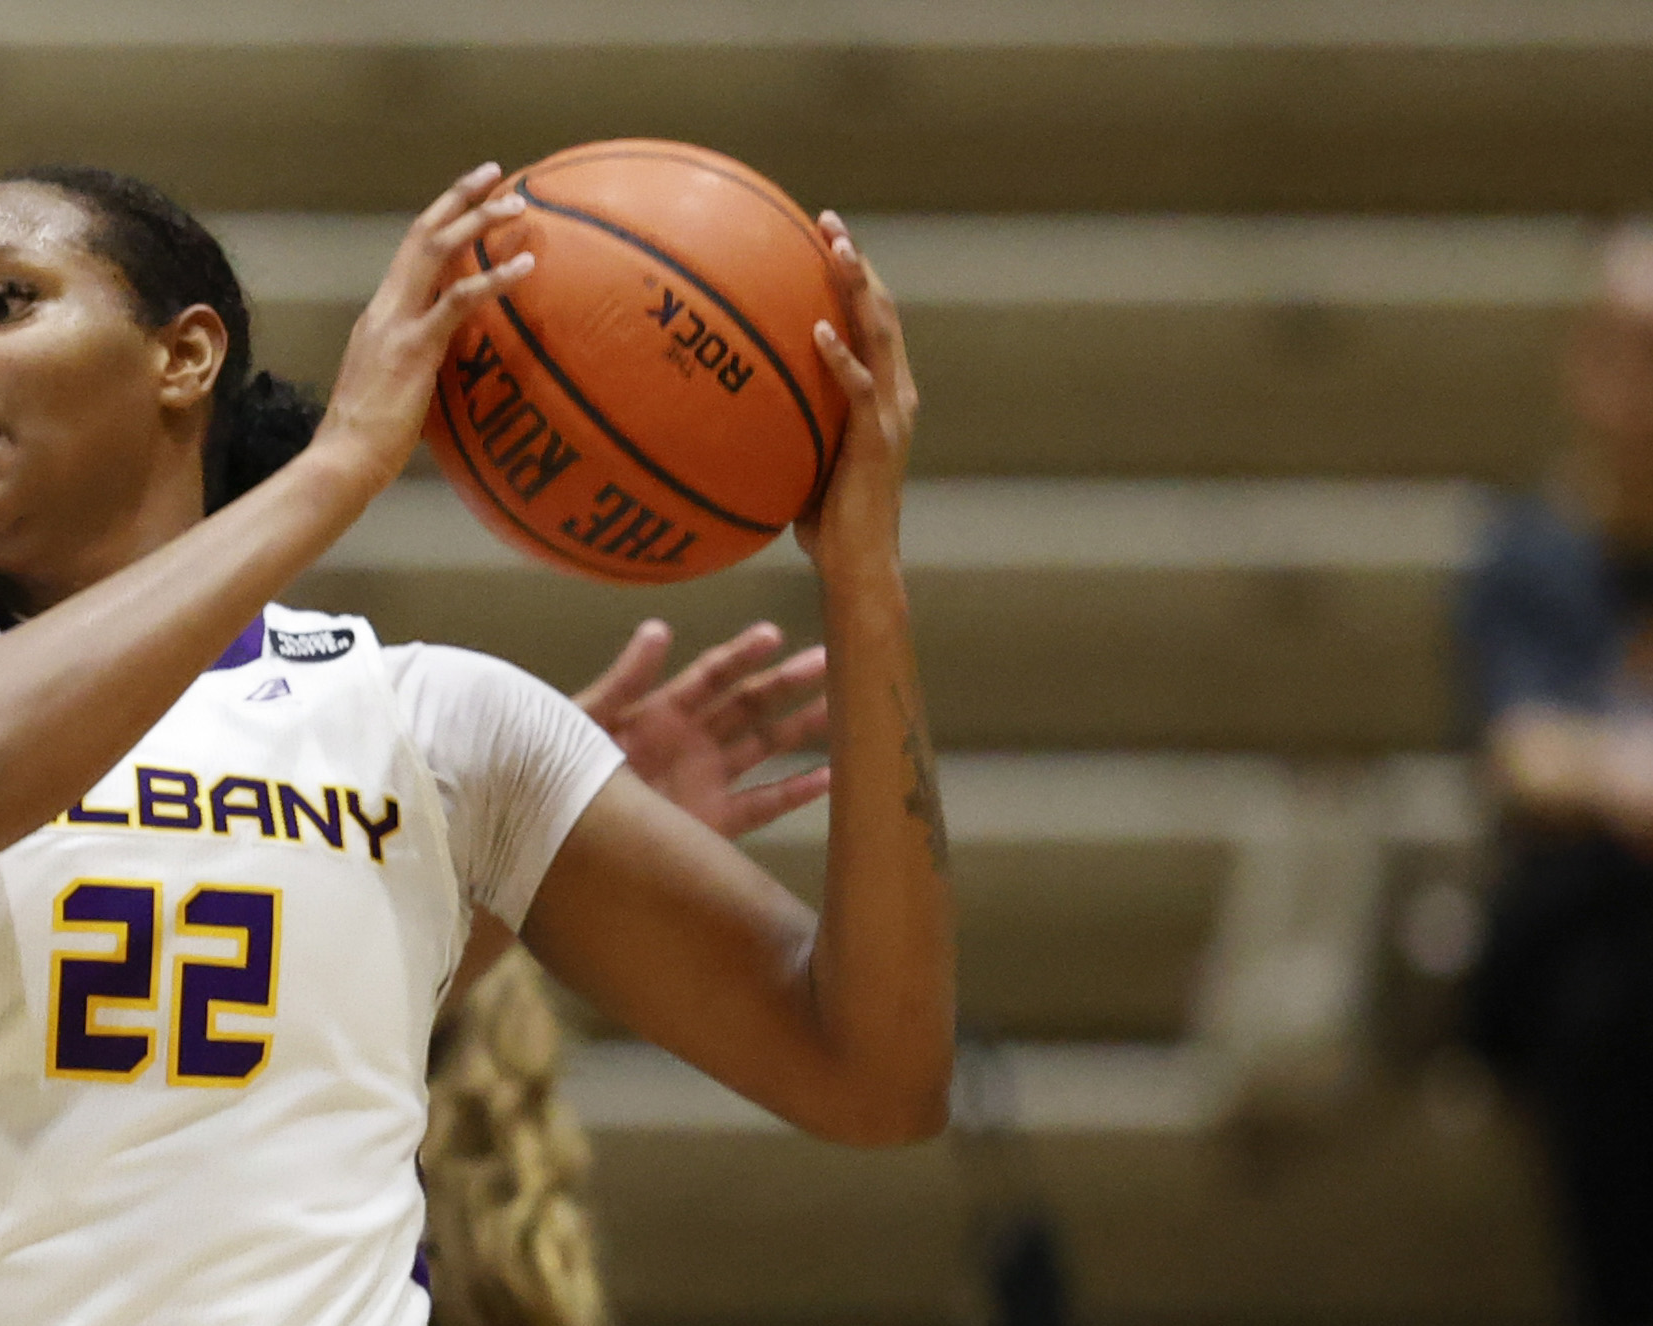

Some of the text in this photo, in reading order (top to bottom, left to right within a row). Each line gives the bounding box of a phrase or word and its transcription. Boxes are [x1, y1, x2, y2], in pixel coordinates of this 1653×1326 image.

[645, 287, 754, 394] ROCK
[456, 334, 698, 564] THE ROCK
[51, 763, 401, 865] LBANY
[46, 876, 283, 1089] 22
